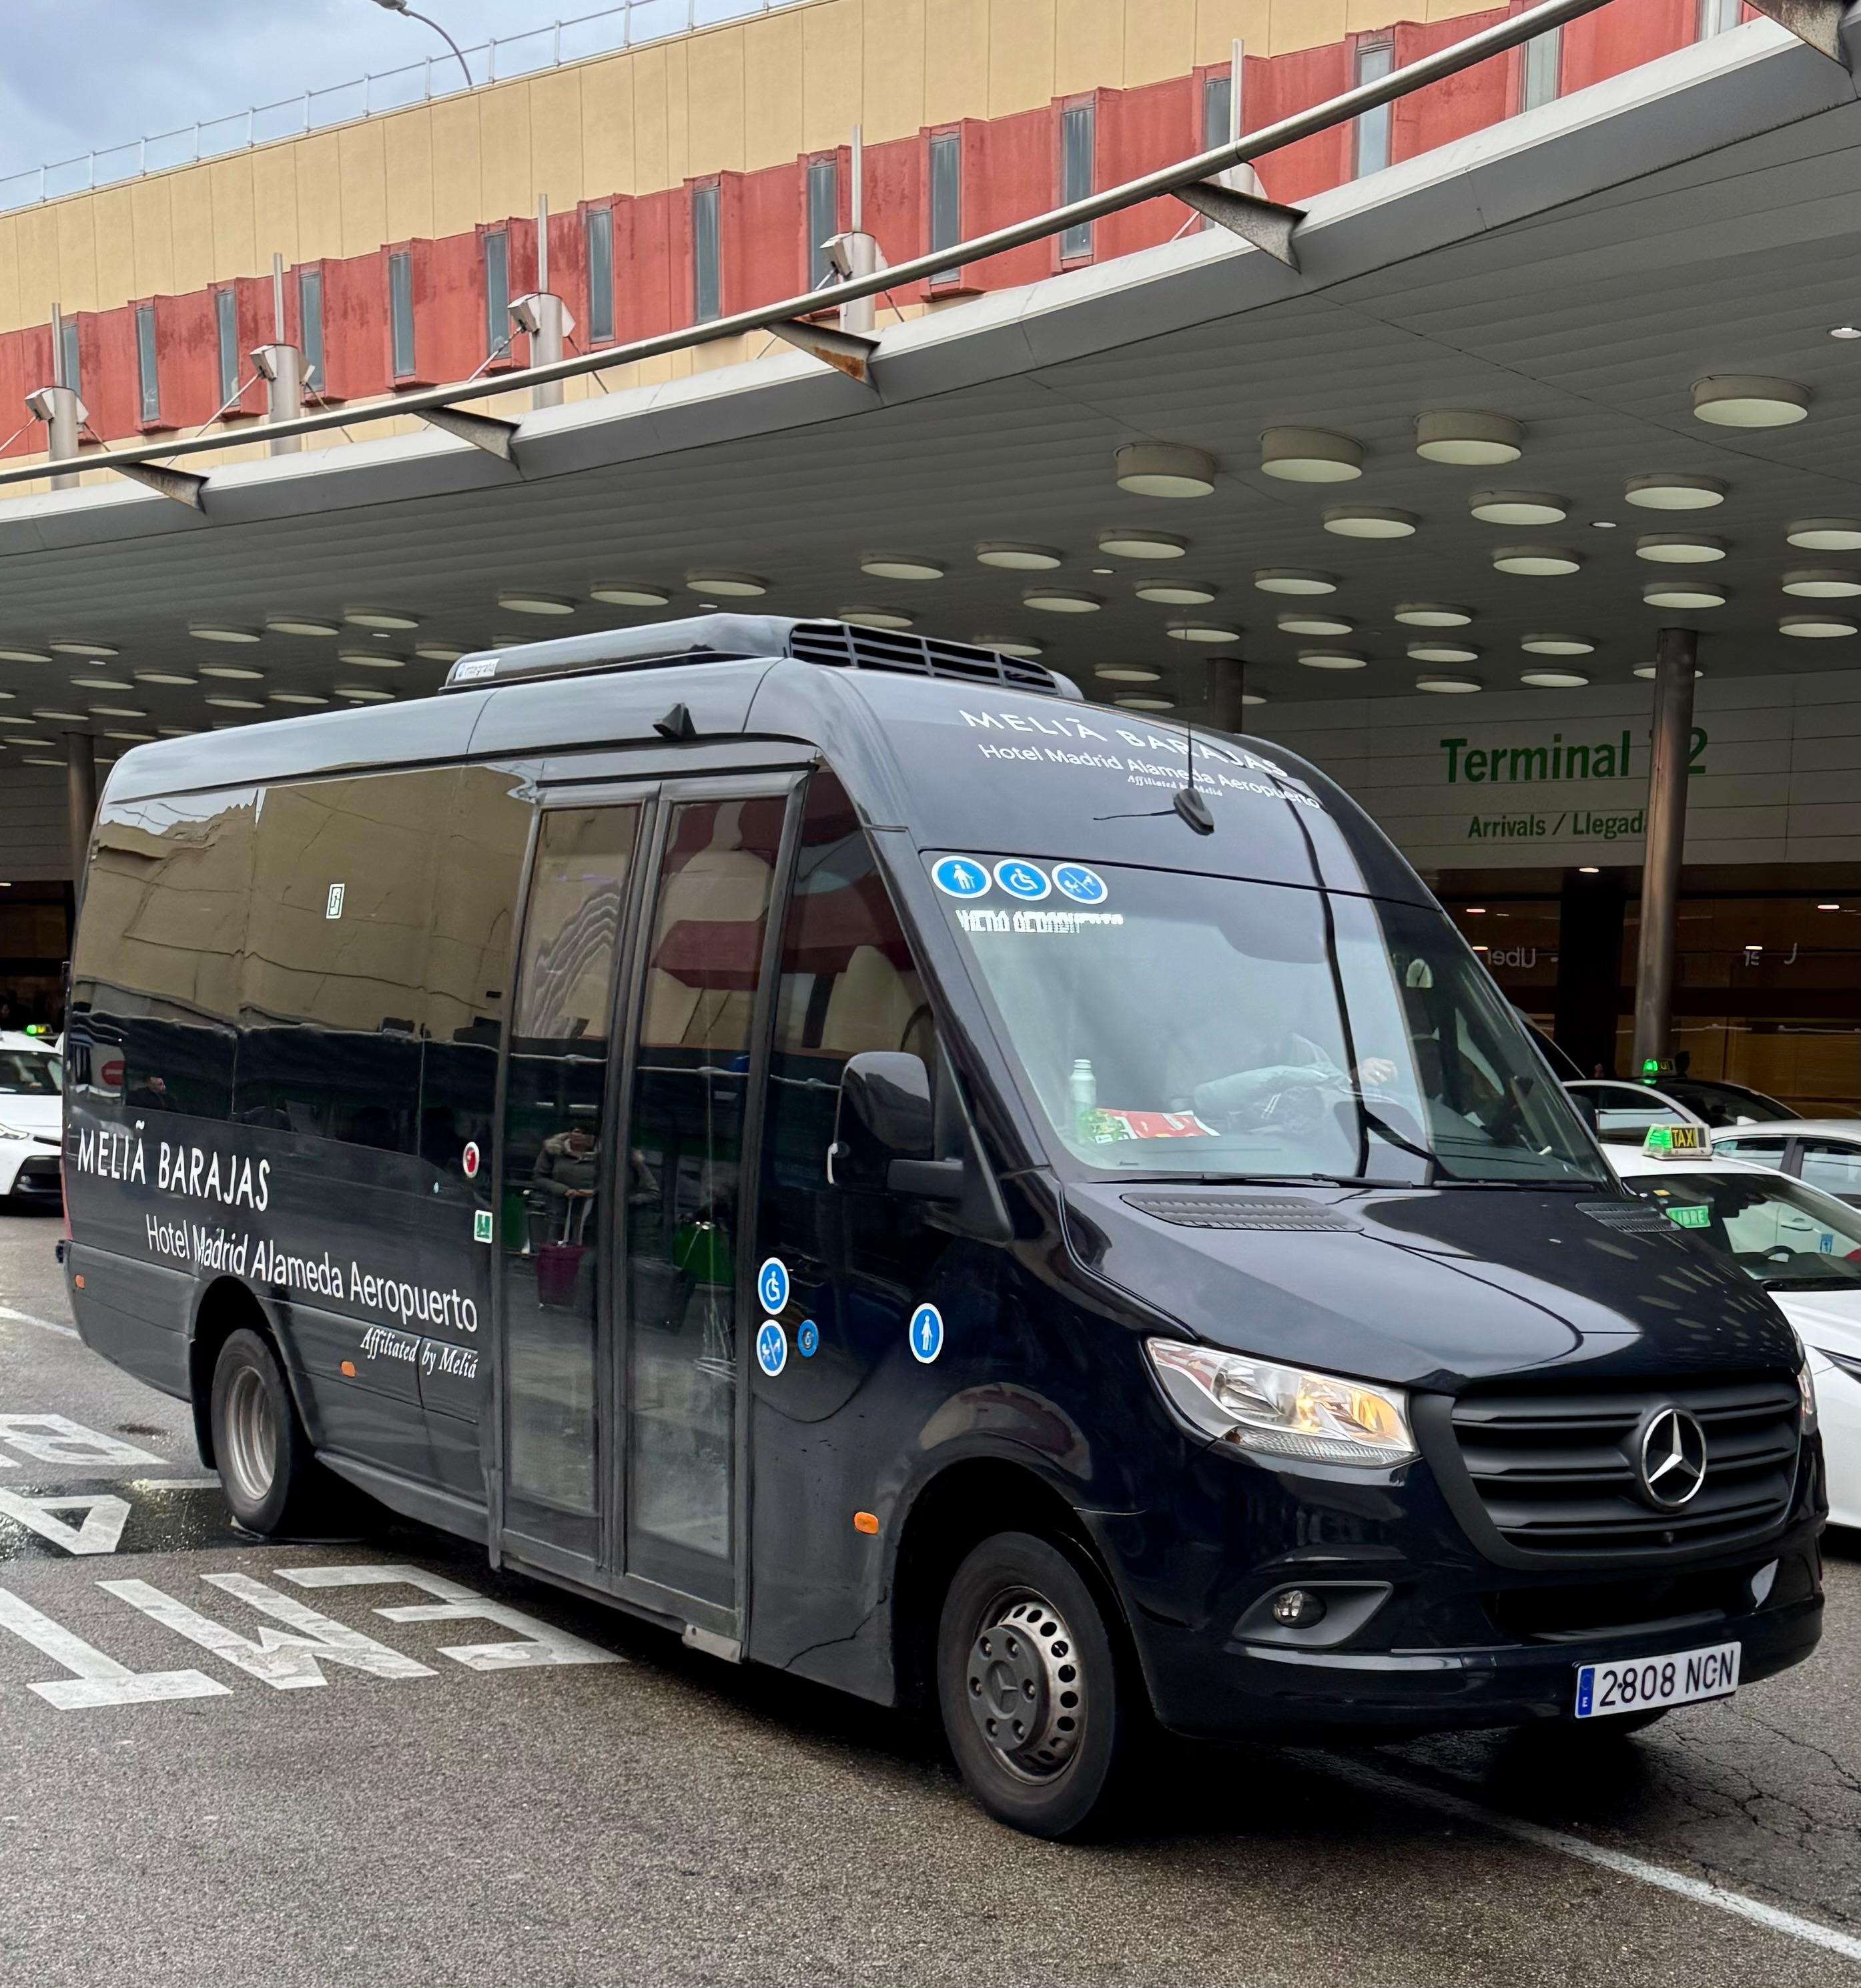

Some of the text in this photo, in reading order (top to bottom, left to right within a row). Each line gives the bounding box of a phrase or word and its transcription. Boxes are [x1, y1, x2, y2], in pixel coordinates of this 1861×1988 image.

[979, 744, 1320, 809] Hotel Madrid Alameda Aeropuerto
[1116, 729, 1288, 777] BARAJAS
[1440, 730, 1631, 784] Terminal
[1127, 775, 1177, 790] Affiliated
[1469, 808, 1647, 840] Arrivals / Llegad
[1672, 1129, 1696, 1147] TAXI
[158, 1141, 271, 1211] BARAJAS
[145, 1213, 478, 1332] Hotel Madrid Alameda Aeropuerto
[360, 1327, 478, 1379] Affiliated by Meliá
[1599, 1662, 1676, 1707] 2808
